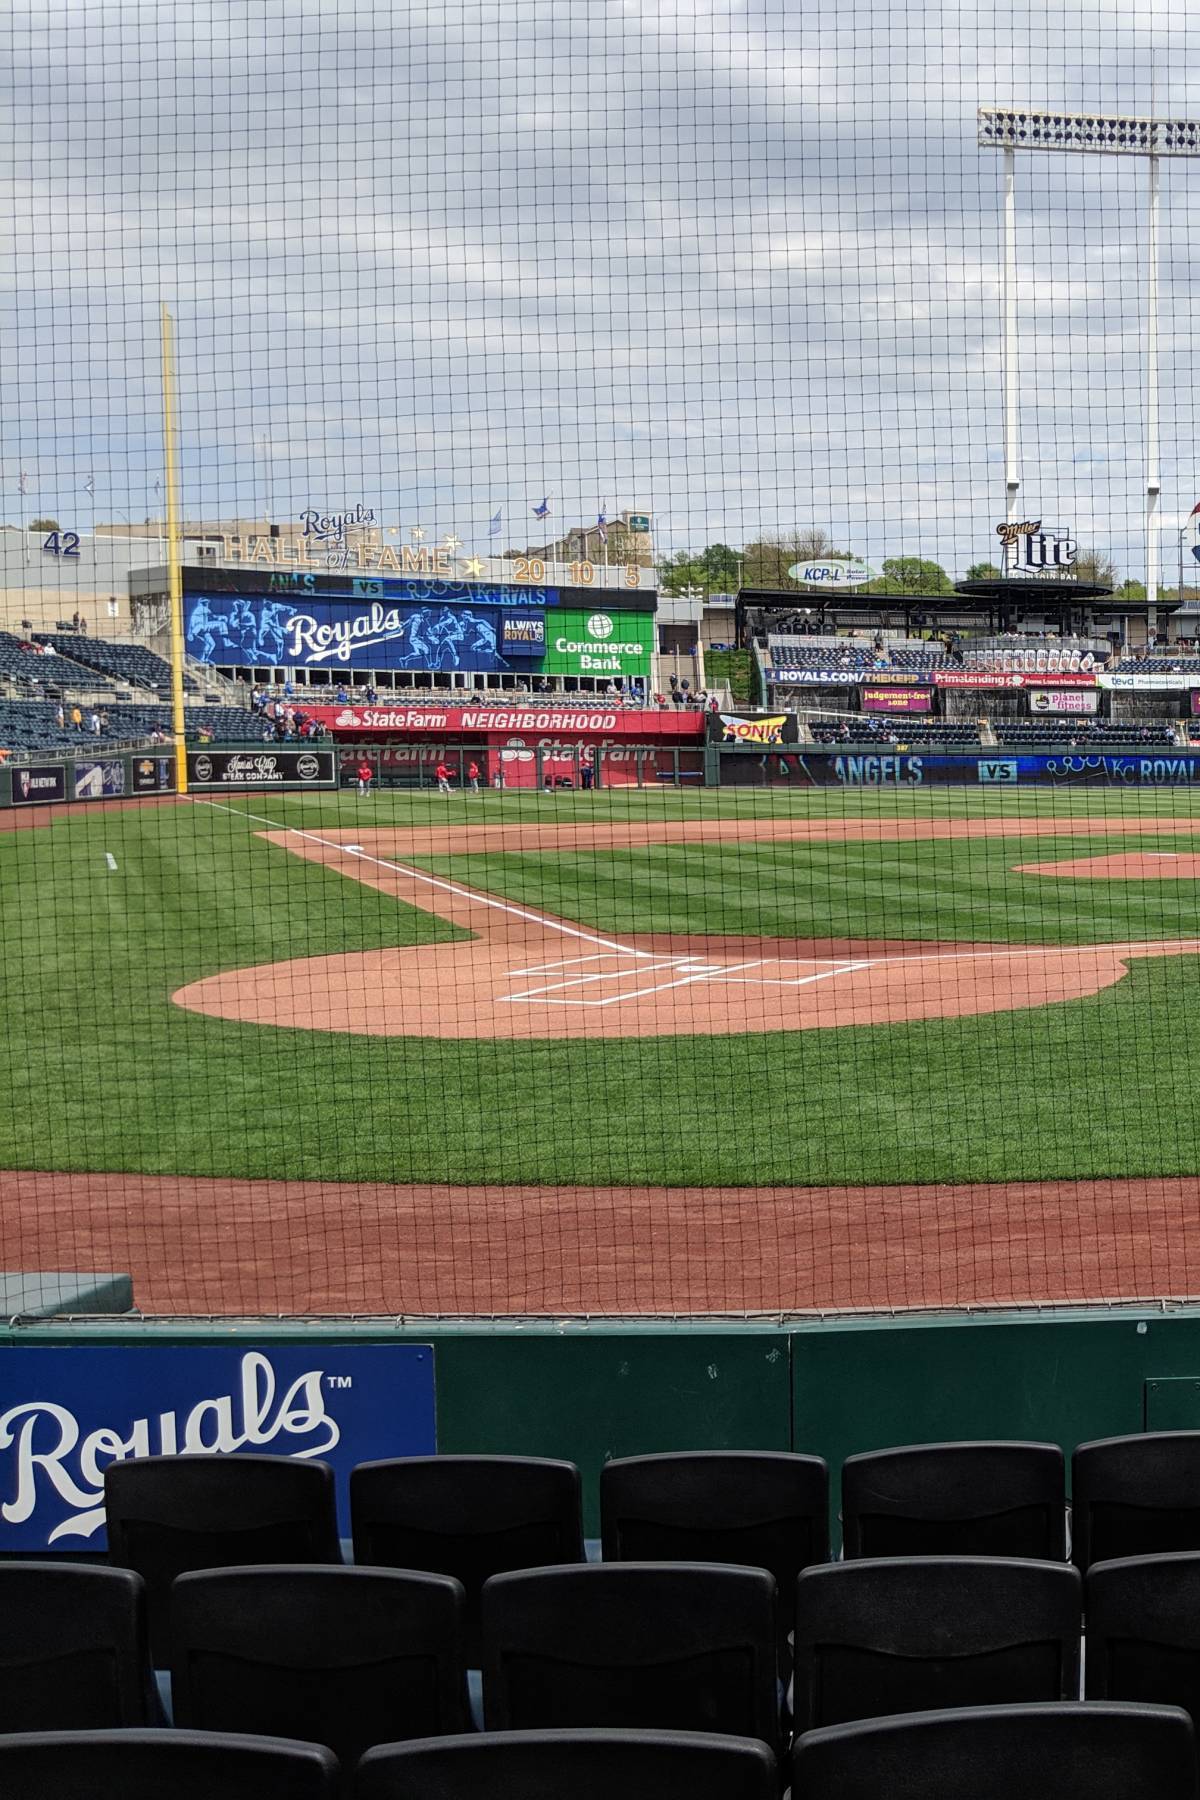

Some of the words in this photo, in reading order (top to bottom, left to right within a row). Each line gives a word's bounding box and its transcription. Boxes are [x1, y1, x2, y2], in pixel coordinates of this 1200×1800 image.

[300, 504, 377, 540] Royals
[997, 520, 1041, 545] Miller
[43, 531, 81, 557] 42
[223, 535, 319, 566] HALL
[326, 549, 350, 574] of
[357, 543, 453, 575] FAME
[1013, 532, 1078, 573] Lite
[513, 557, 545, 582] 20
[569, 560, 594, 585] 10
[625, 564, 640, 588] 5
[804, 567, 841, 581] KCP&L
[359, 581, 380, 594] VS
[286, 602, 403, 664] Royals
[504, 620, 544, 631] ALWAYS
[504, 630, 535, 641] ROYAL
[556, 637, 643, 655] Commerce
[580, 655, 621, 670] Bank
[1111, 676, 1134, 686] teva
[1052, 692, 1085, 703] planet
[1057, 700, 1092, 711] fitness
[461, 712, 617, 730] NEIGHBORHOOD
[727, 723, 782, 738] SONIC
[222, 772, 245, 780] STEAK
[246, 772, 283, 780] COMPANY
[835, 755, 923, 785] ANGELS
[987, 764, 1011, 778] VS
[1112, 759, 1135, 784] KC
[327, 1376, 352, 1389] TM
